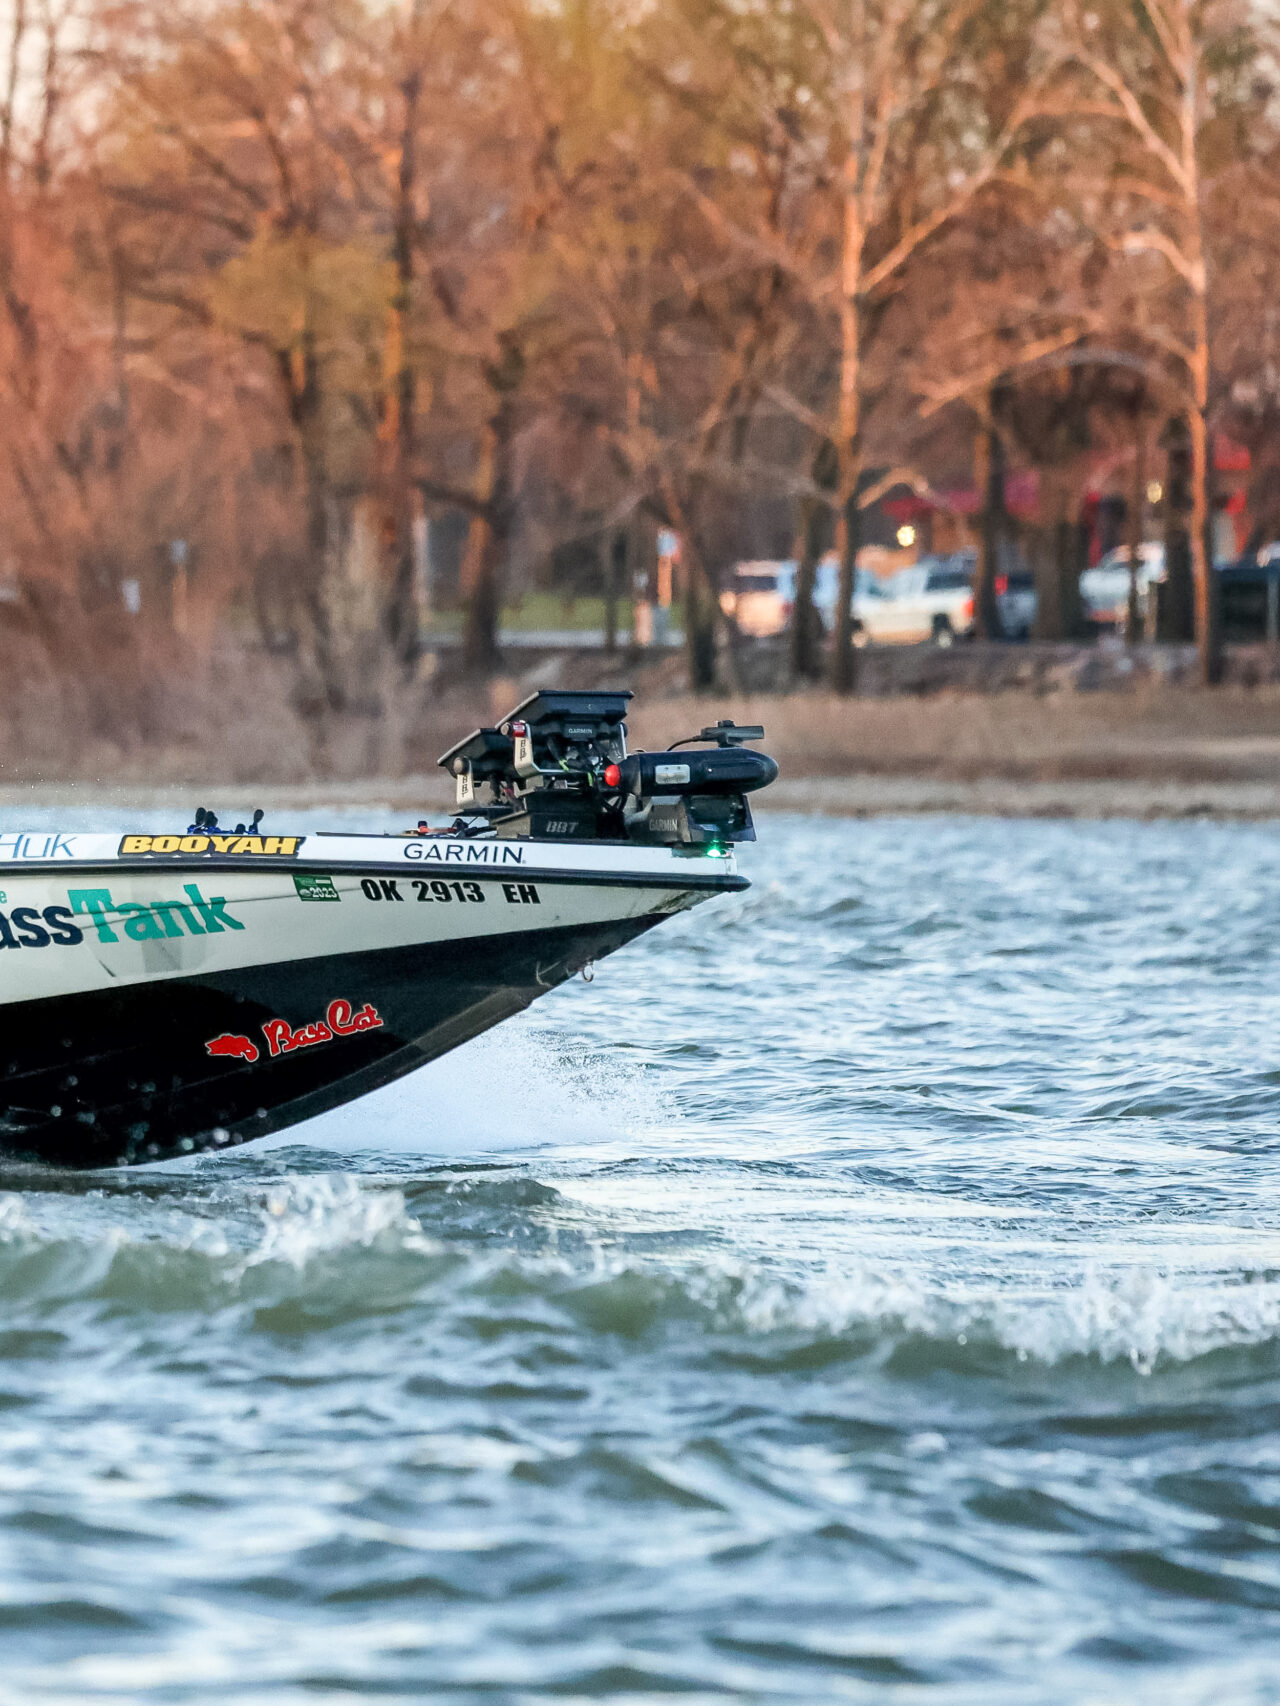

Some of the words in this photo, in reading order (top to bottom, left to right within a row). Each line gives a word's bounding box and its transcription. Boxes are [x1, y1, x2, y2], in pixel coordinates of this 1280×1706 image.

[546, 821, 579, 833] BBT
[649, 819, 678, 832] GARMIN
[122, 836, 298, 855] BOOYAH
[404, 843, 523, 863] GARMIN
[309, 887, 337, 898] 2023
[361, 879, 404, 901] OK
[412, 881, 486, 903] 2913
[502, 884, 541, 904] EH
[68, 884, 245, 943] Tank
[327, 999, 384, 1036] Cat
